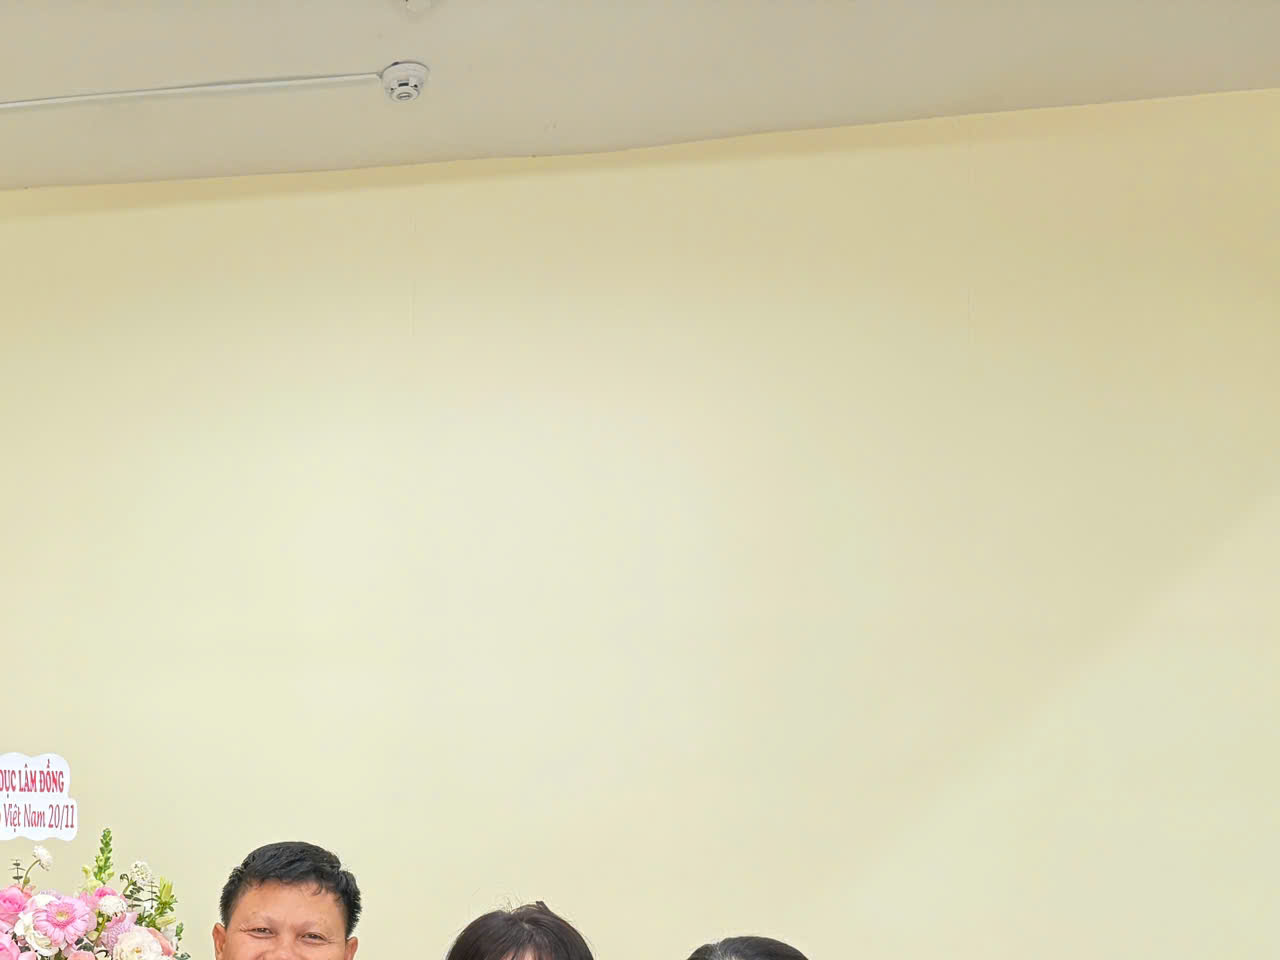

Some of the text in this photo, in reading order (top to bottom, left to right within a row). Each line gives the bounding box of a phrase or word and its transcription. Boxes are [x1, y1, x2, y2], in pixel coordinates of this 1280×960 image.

[18, 763, 38, 793] LÂM
[39, 758, 65, 793] ĐỒNG
[3, 803, 21, 832] Việt
[24, 804, 46, 828] Nam
[48, 804, 75, 830] 20/11
